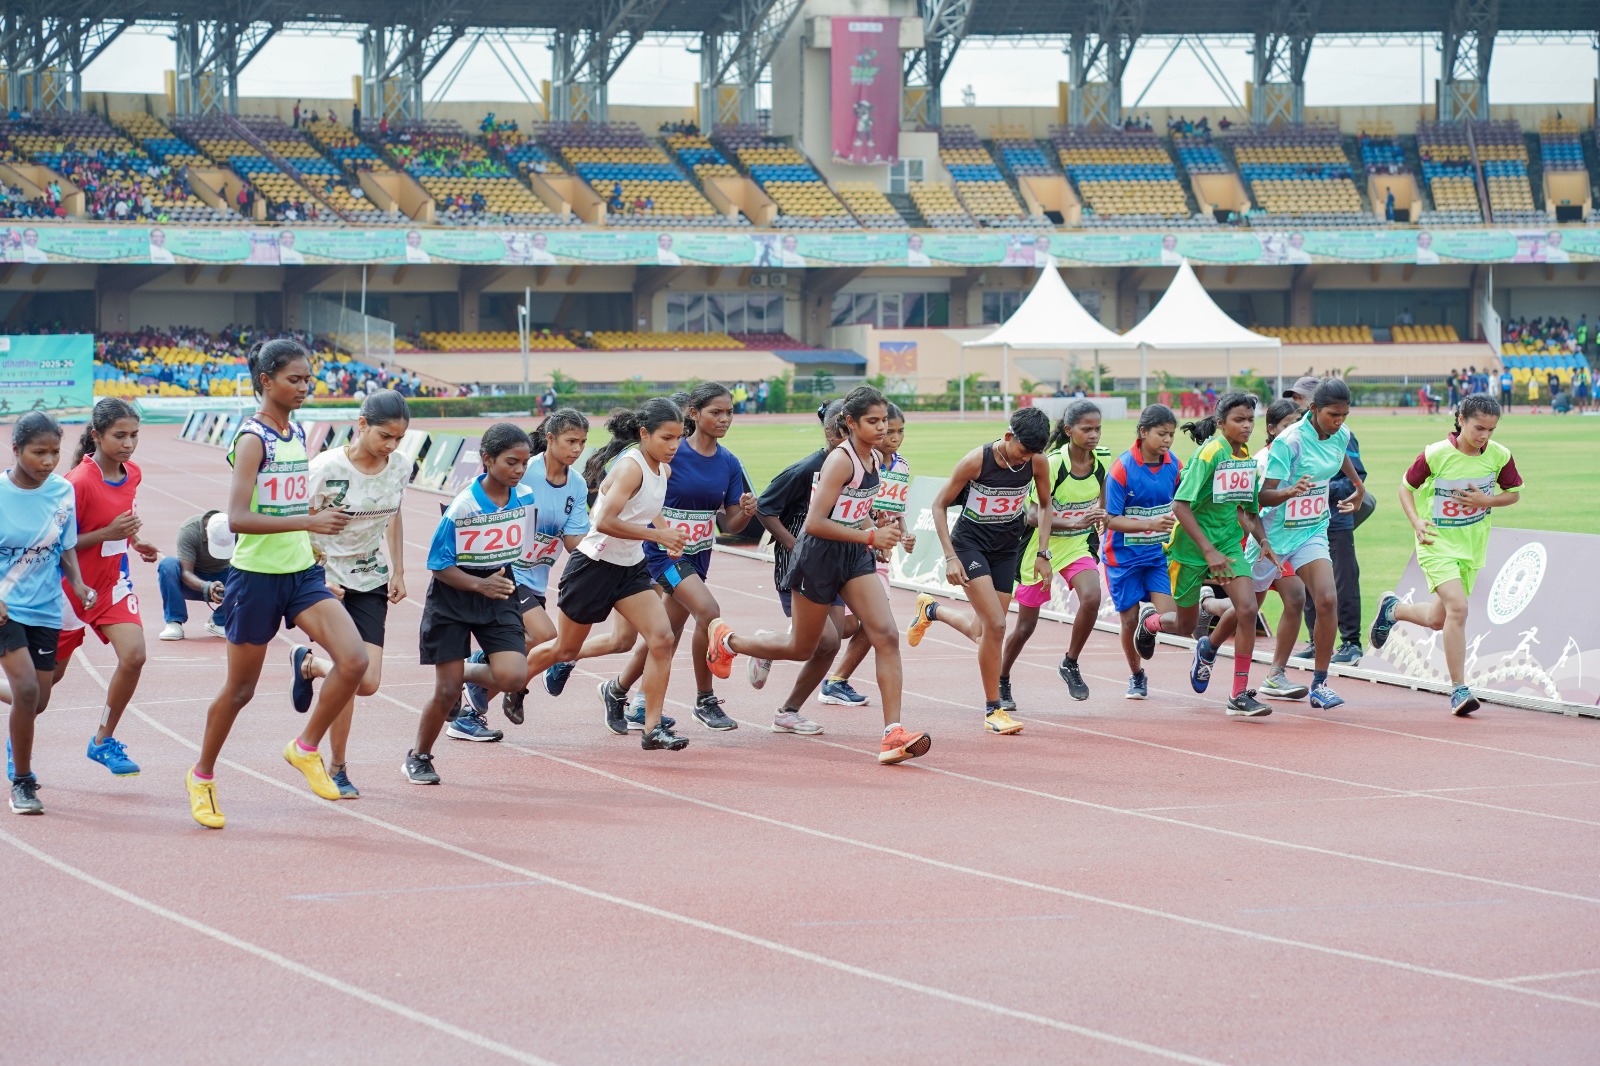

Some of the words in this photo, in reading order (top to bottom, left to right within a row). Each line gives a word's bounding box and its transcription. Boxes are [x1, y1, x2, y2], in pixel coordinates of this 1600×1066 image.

[41, 360, 74, 369] 2025-26
[264, 475, 309, 501] 103
[840, 498, 874, 519] 189
[976, 495, 1025, 514] 138
[459, 524, 522, 551] 720
